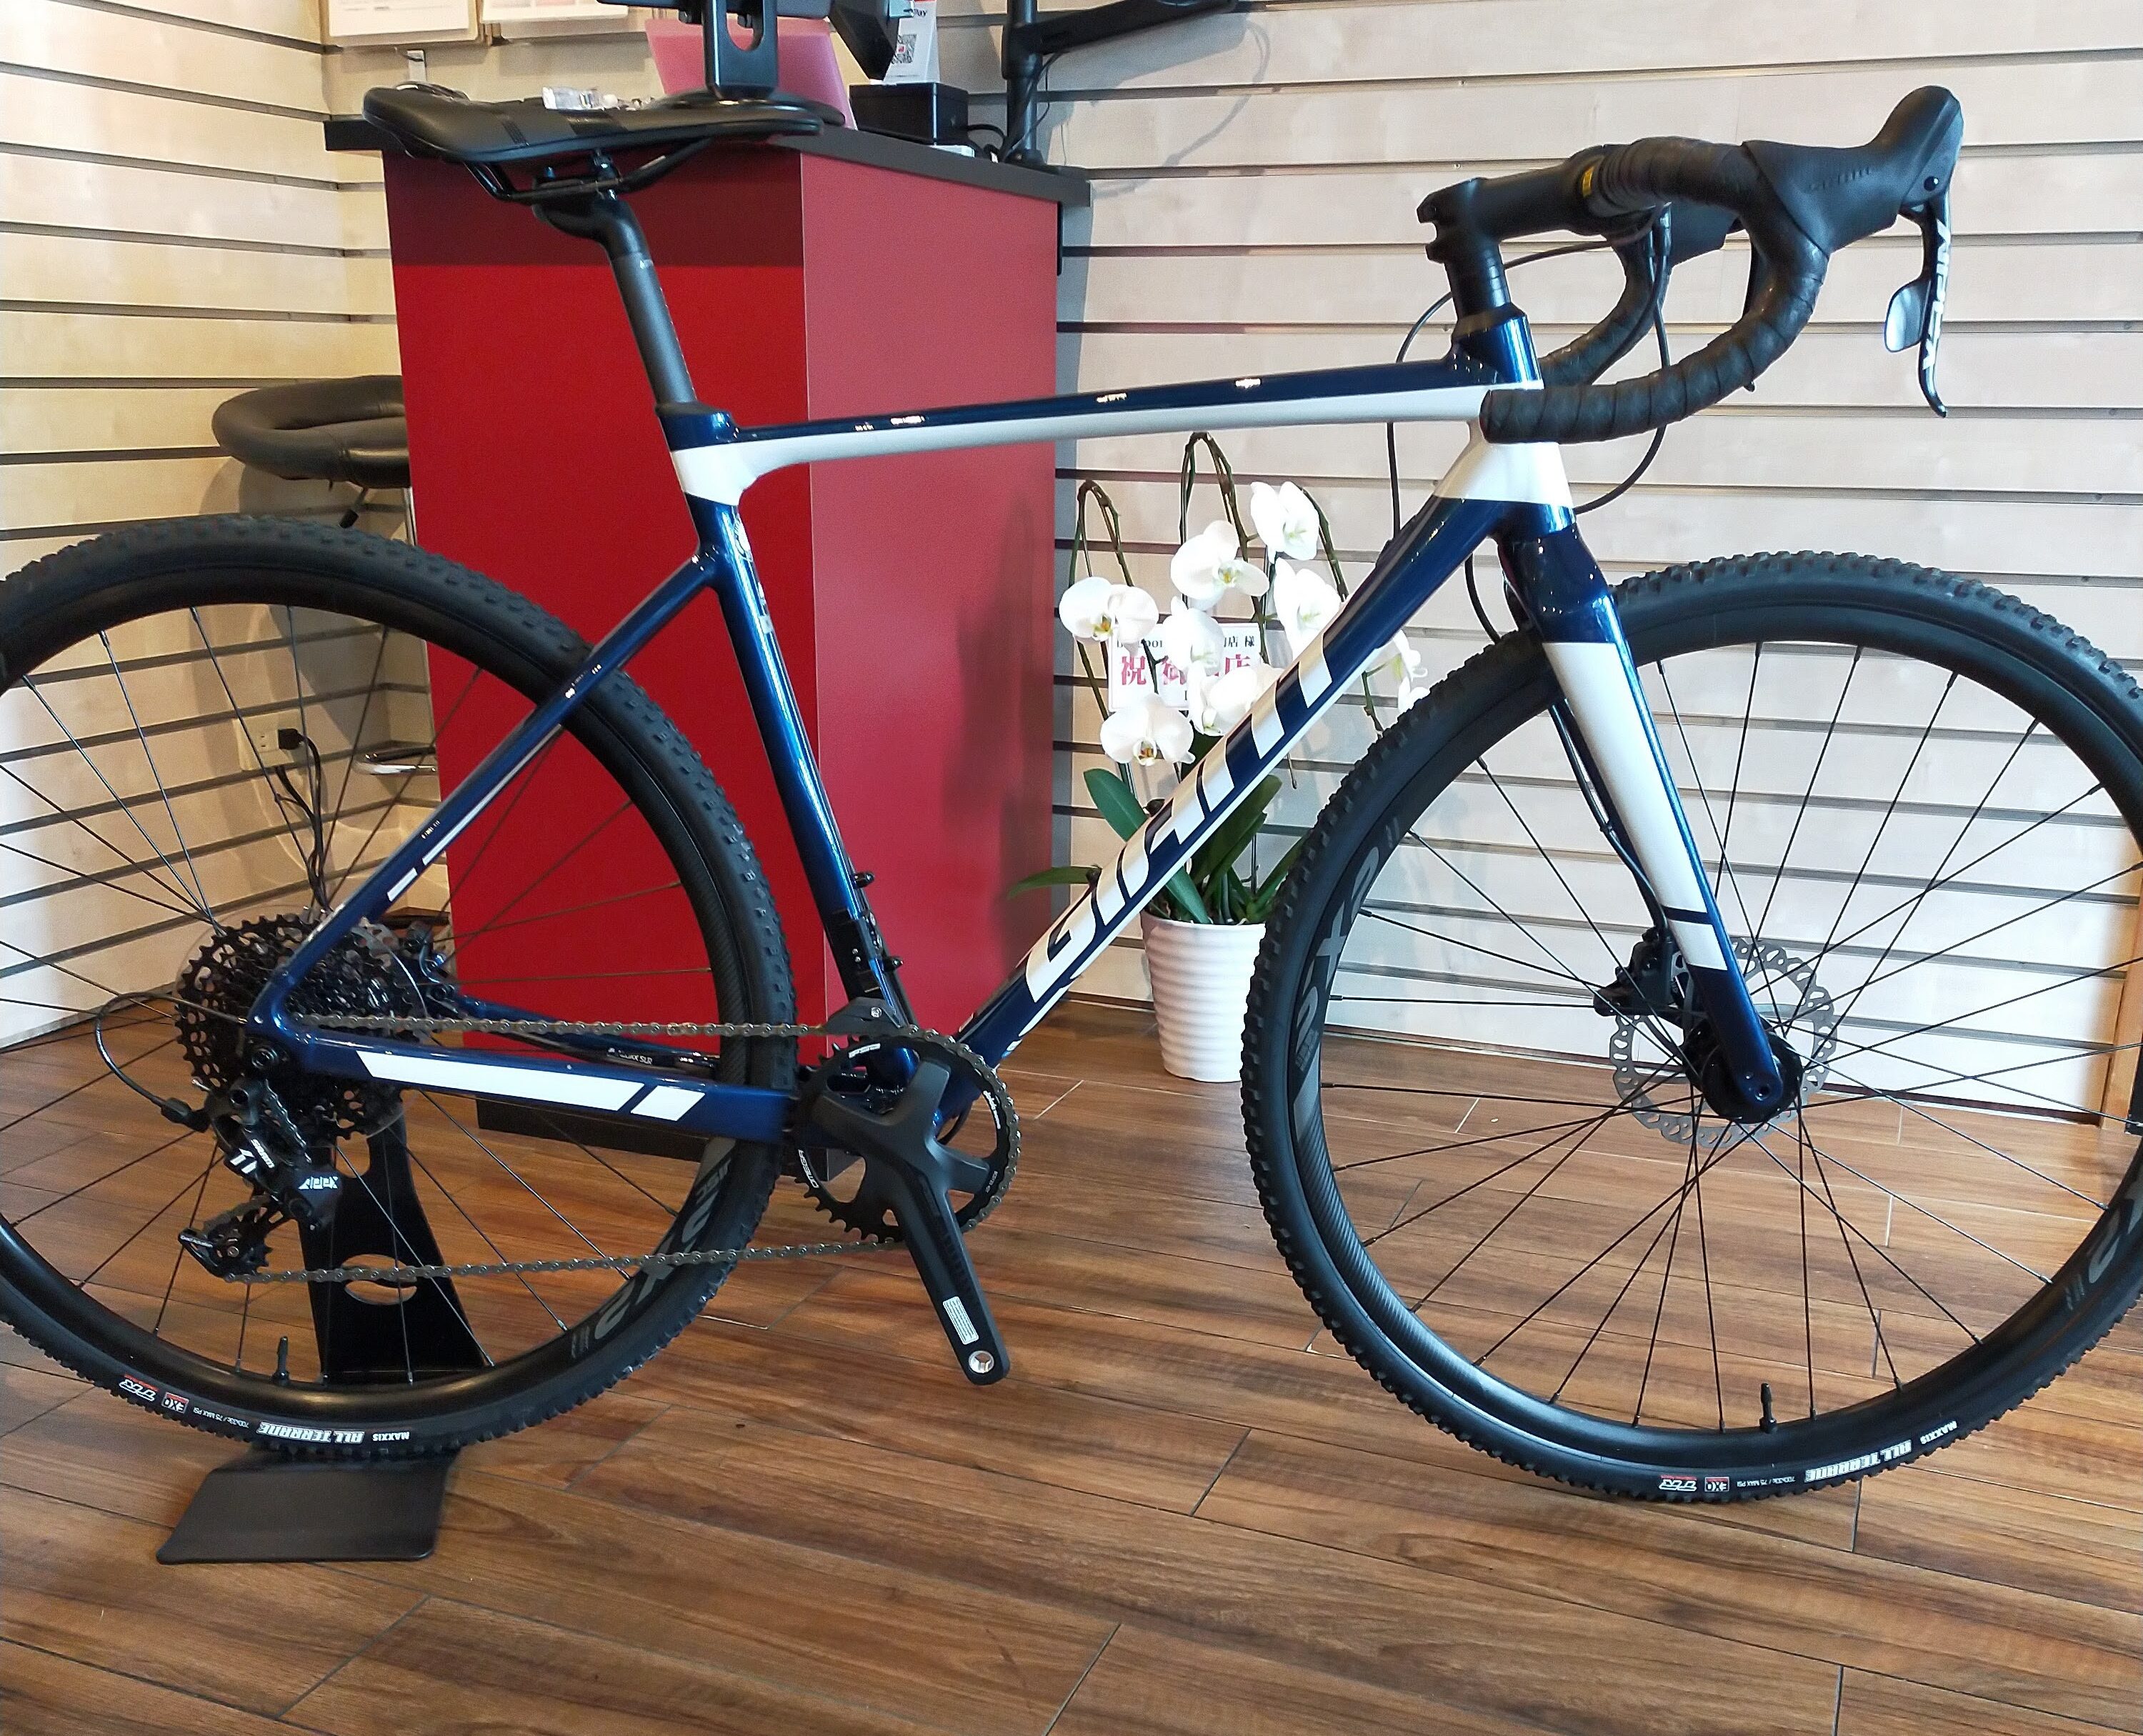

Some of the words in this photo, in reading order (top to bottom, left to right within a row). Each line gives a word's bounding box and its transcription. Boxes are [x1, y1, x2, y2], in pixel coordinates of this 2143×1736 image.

[1026, 606, 1344, 1003] GIANT
[799, 1149, 819, 1189] OMEGA
[164, 1396, 186, 1414] EXO
[256, 1421, 331, 1443] TERRANE
[334, 1430, 365, 1445] ALL
[372, 1431, 410, 1442] MAXXIS
[1920, 1421, 1958, 1445] MAXXIS
[1881, 1440, 1912, 1461] ALL
[1805, 1451, 1881, 1482] TERRANE
[1705, 1481, 1729, 1492] EXO
